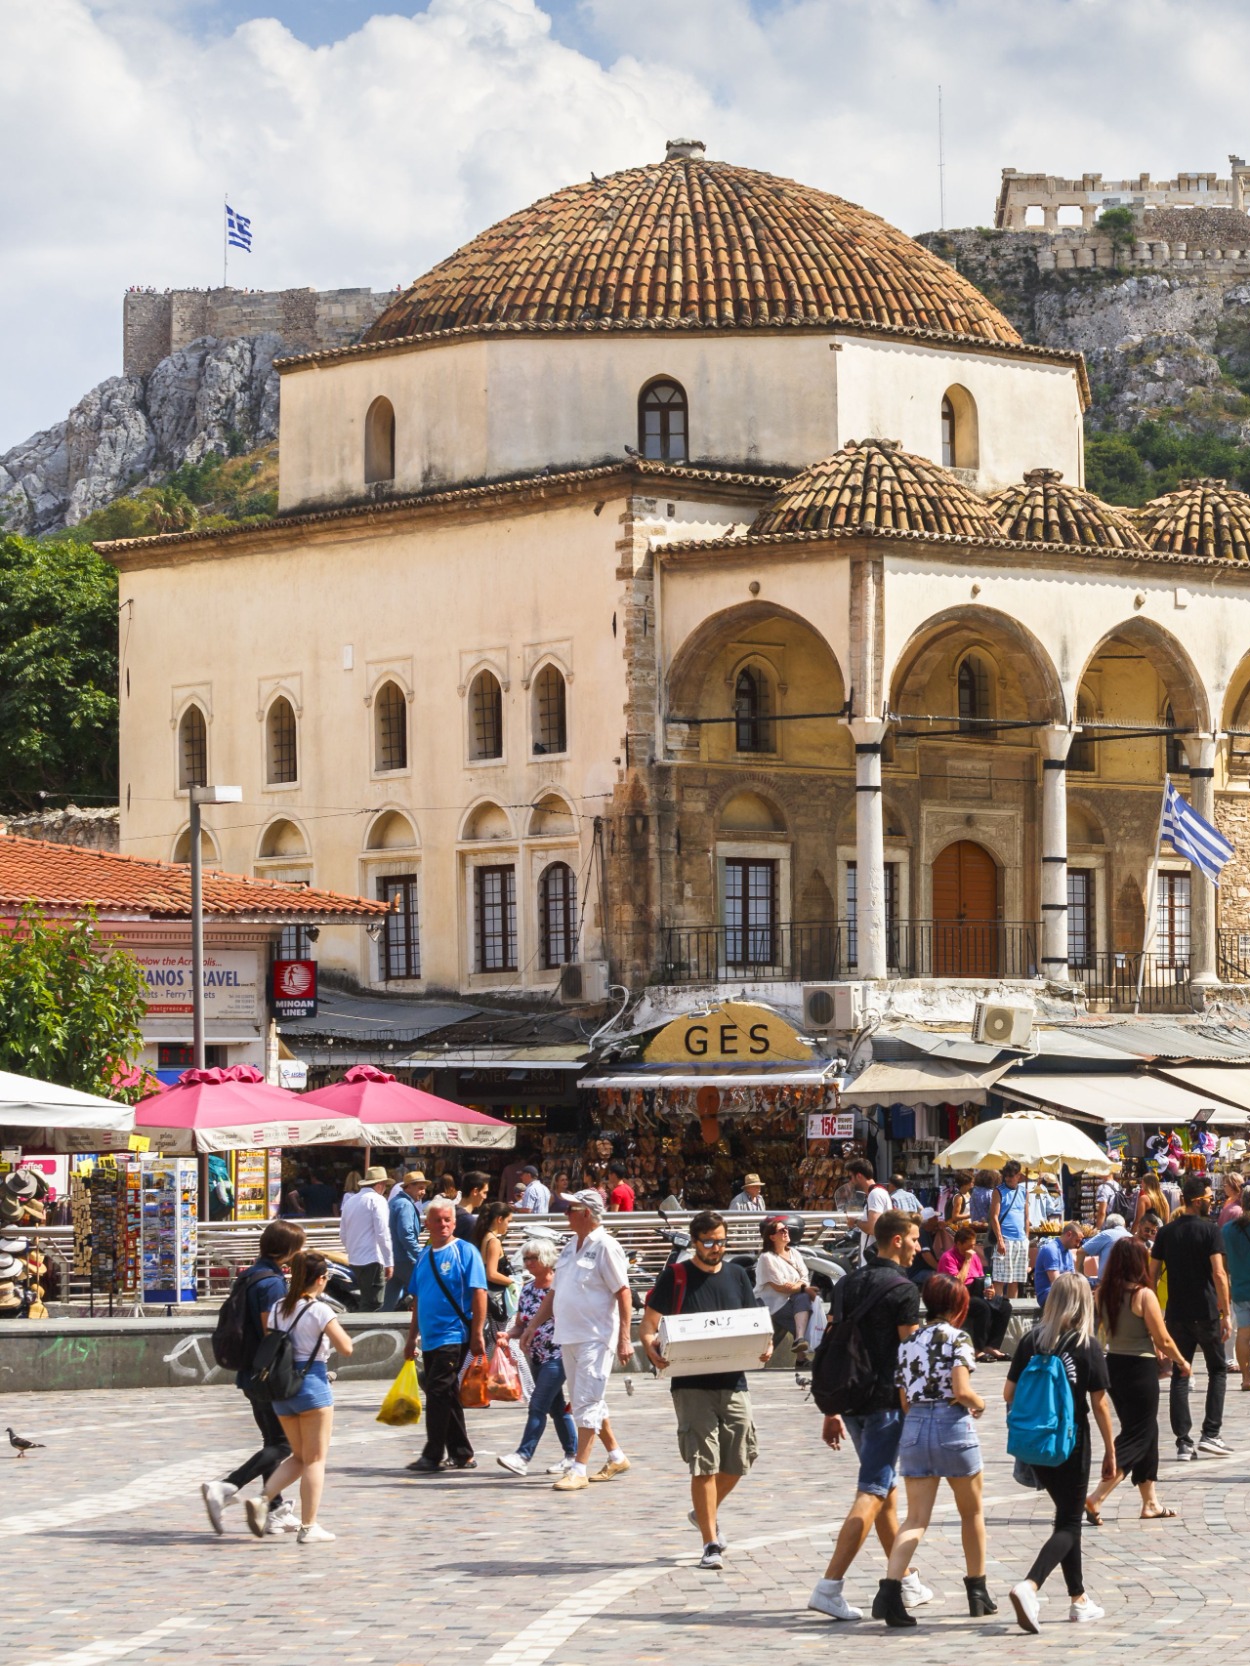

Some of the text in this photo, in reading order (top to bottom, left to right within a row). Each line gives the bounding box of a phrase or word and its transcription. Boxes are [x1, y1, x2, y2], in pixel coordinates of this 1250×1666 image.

[162, 956, 176, 966] the
[166, 990, 187, 1001] Ferry
[275, 1000, 314, 1008] MINOAN
[282, 1009, 307, 1017] LINES
[684, 1023, 770, 1056] GES
[19, 1162, 44, 1171] coffee
